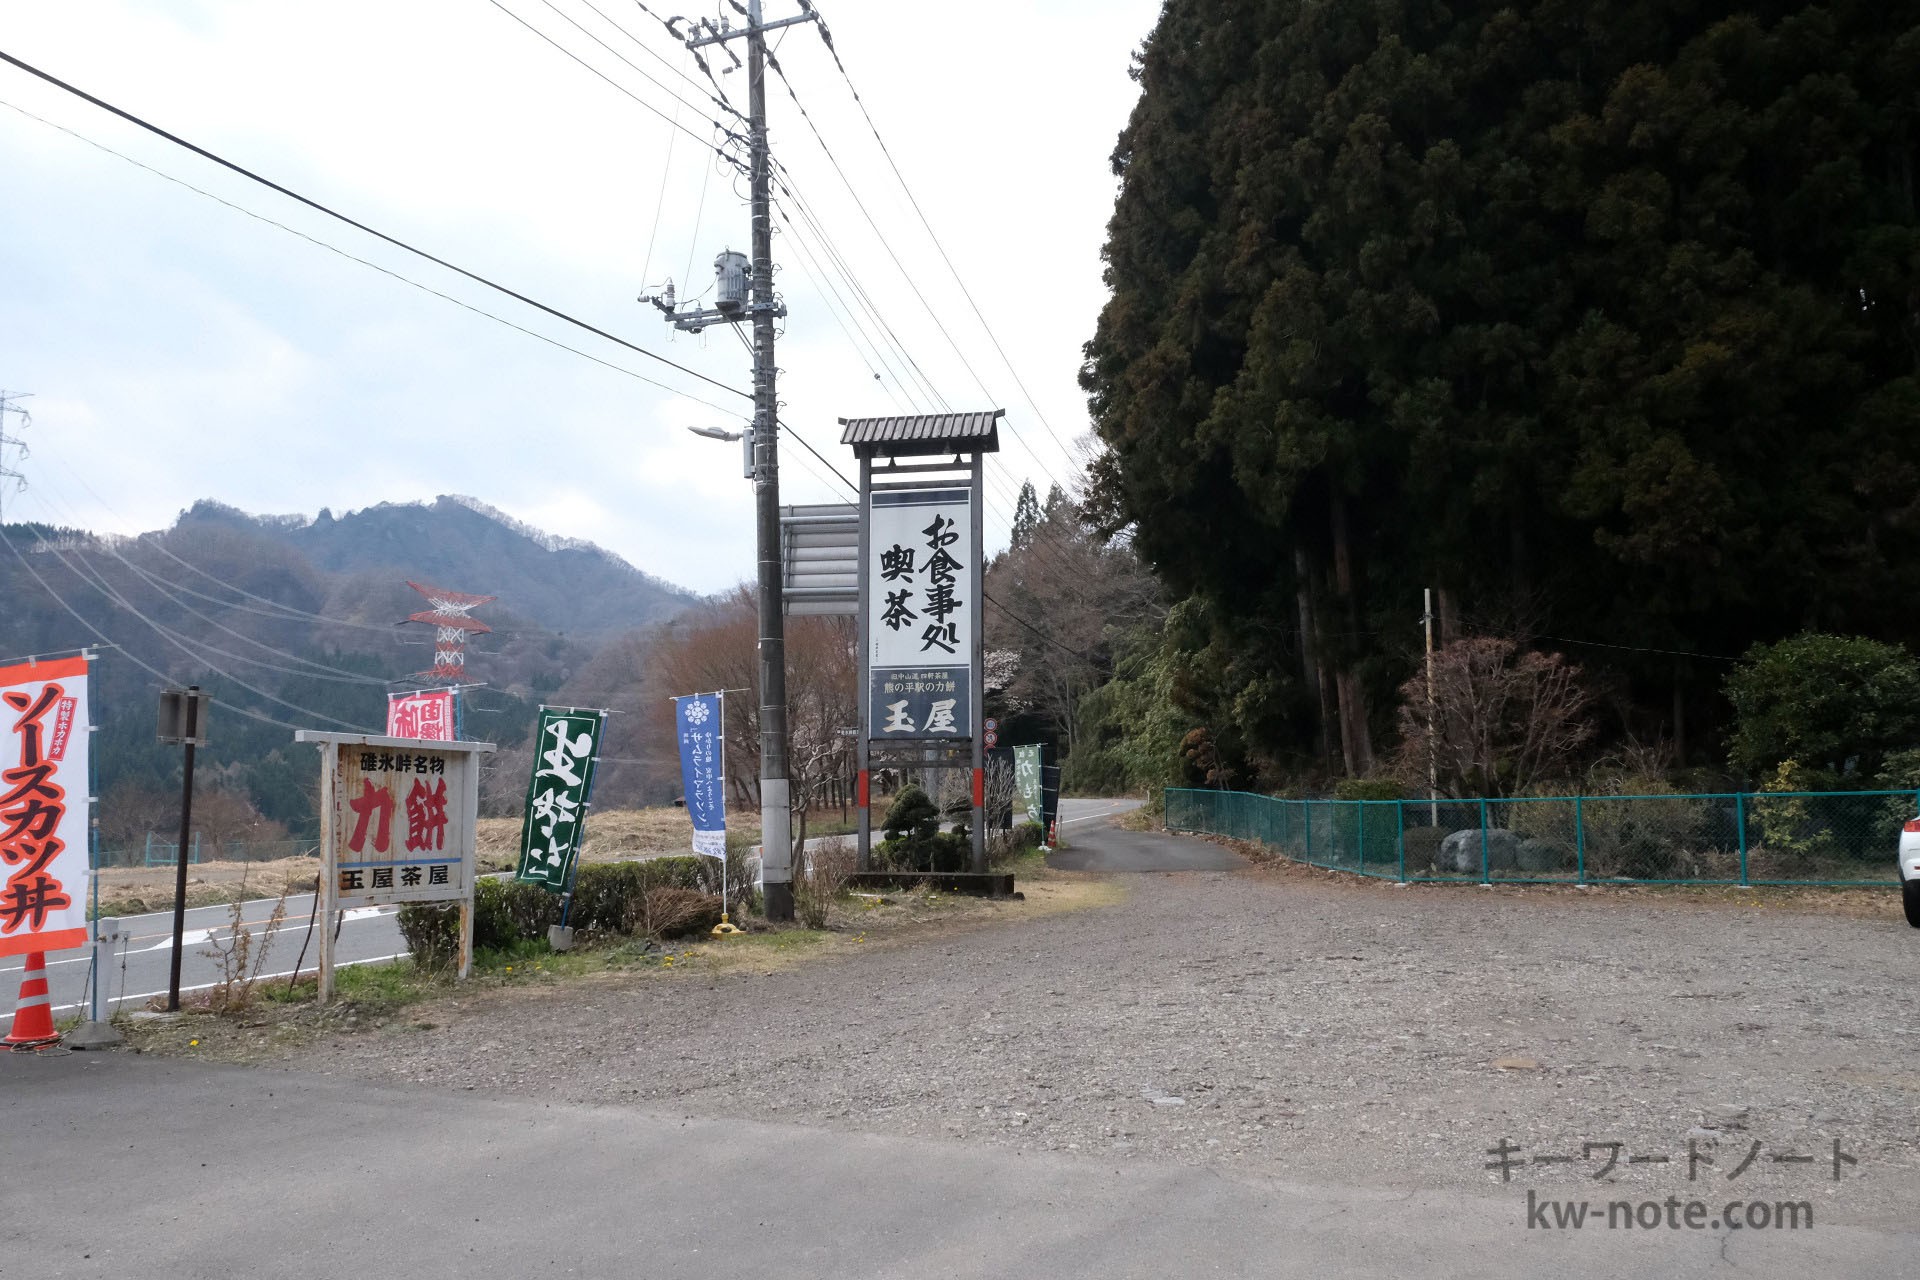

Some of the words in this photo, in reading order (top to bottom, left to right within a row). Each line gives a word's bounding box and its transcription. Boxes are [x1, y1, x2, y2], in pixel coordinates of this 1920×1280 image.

[880, 543, 919, 632] 喫茶
[918, 513, 964, 654] お食事処
[882, 698, 958, 733] 玉屋
[884, 680, 956, 694] 熊の平駅の力餅
[50, 699, 73, 756] 特製ホカホカ
[360, 752, 445, 775] 碓氷峠名物
[0, 685, 68, 930] ソースカツ丼
[348, 777, 449, 853] 力餅
[340, 864, 449, 891] 玉屋茶屋
